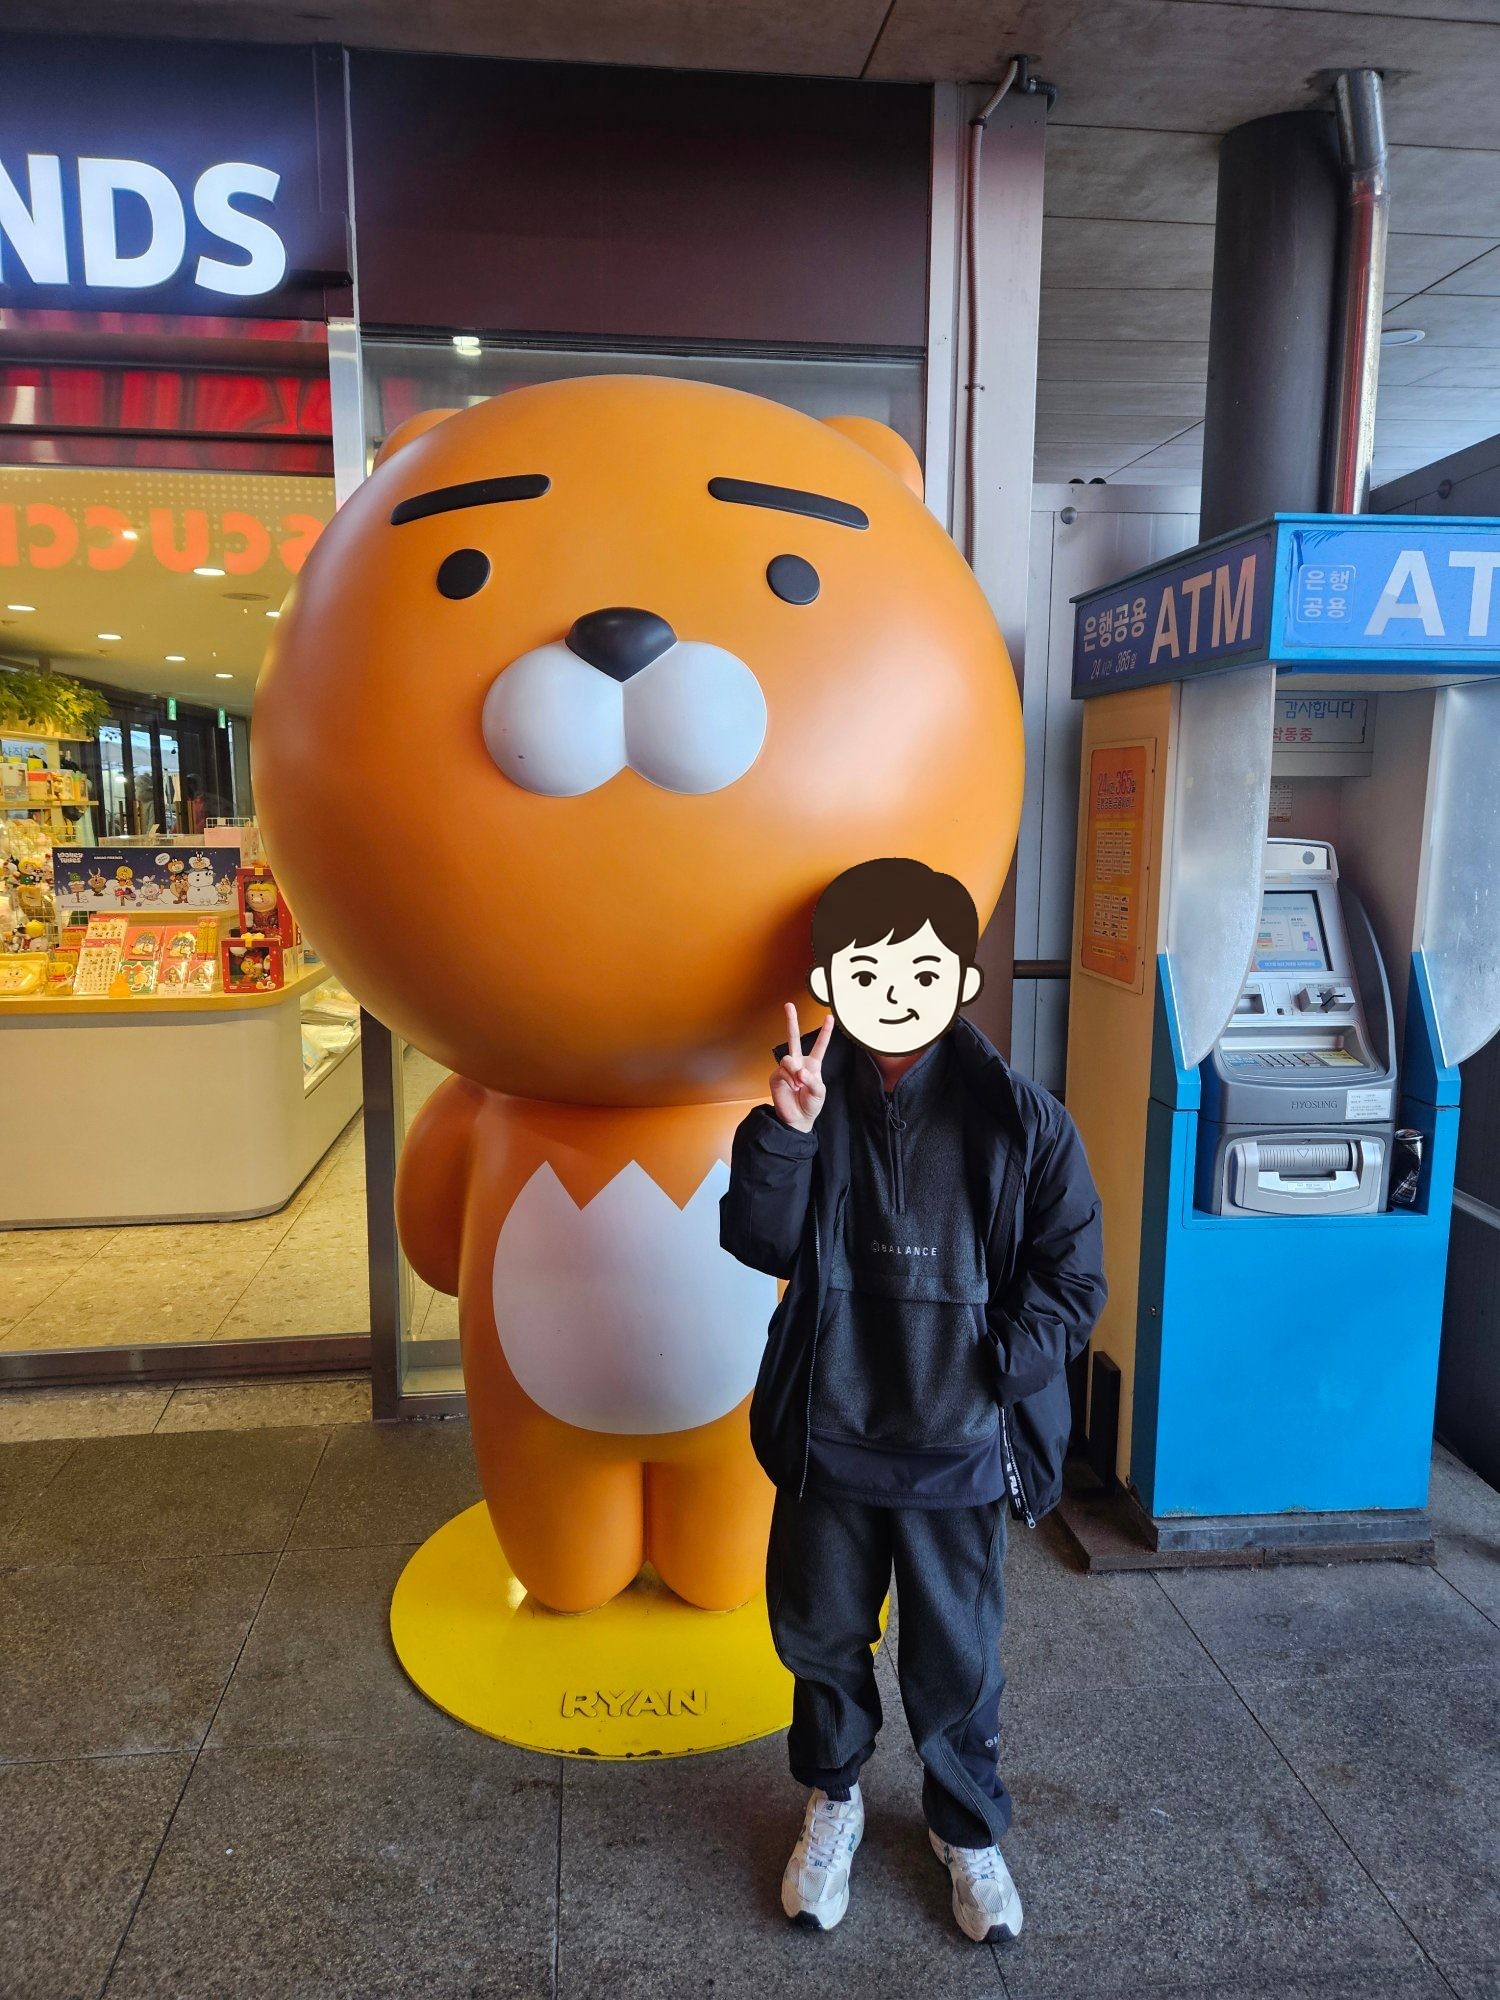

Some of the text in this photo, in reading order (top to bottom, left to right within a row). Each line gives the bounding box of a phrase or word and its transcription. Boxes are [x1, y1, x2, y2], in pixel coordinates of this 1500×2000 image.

[0, 154, 287, 296] NDS
[1304, 569, 1351, 592] 은행
[1364, 550, 1500, 637] AT
[1149, 554, 1257, 665] ATM
[1302, 596, 1347, 619] 공용
[1083, 597, 1148, 653] 은행공용
[1284, 700, 1356, 719] 감사합니다
[1291, 1100, 1338, 1110] HYOSUNG
[561, 1687, 707, 1719] RYAN
